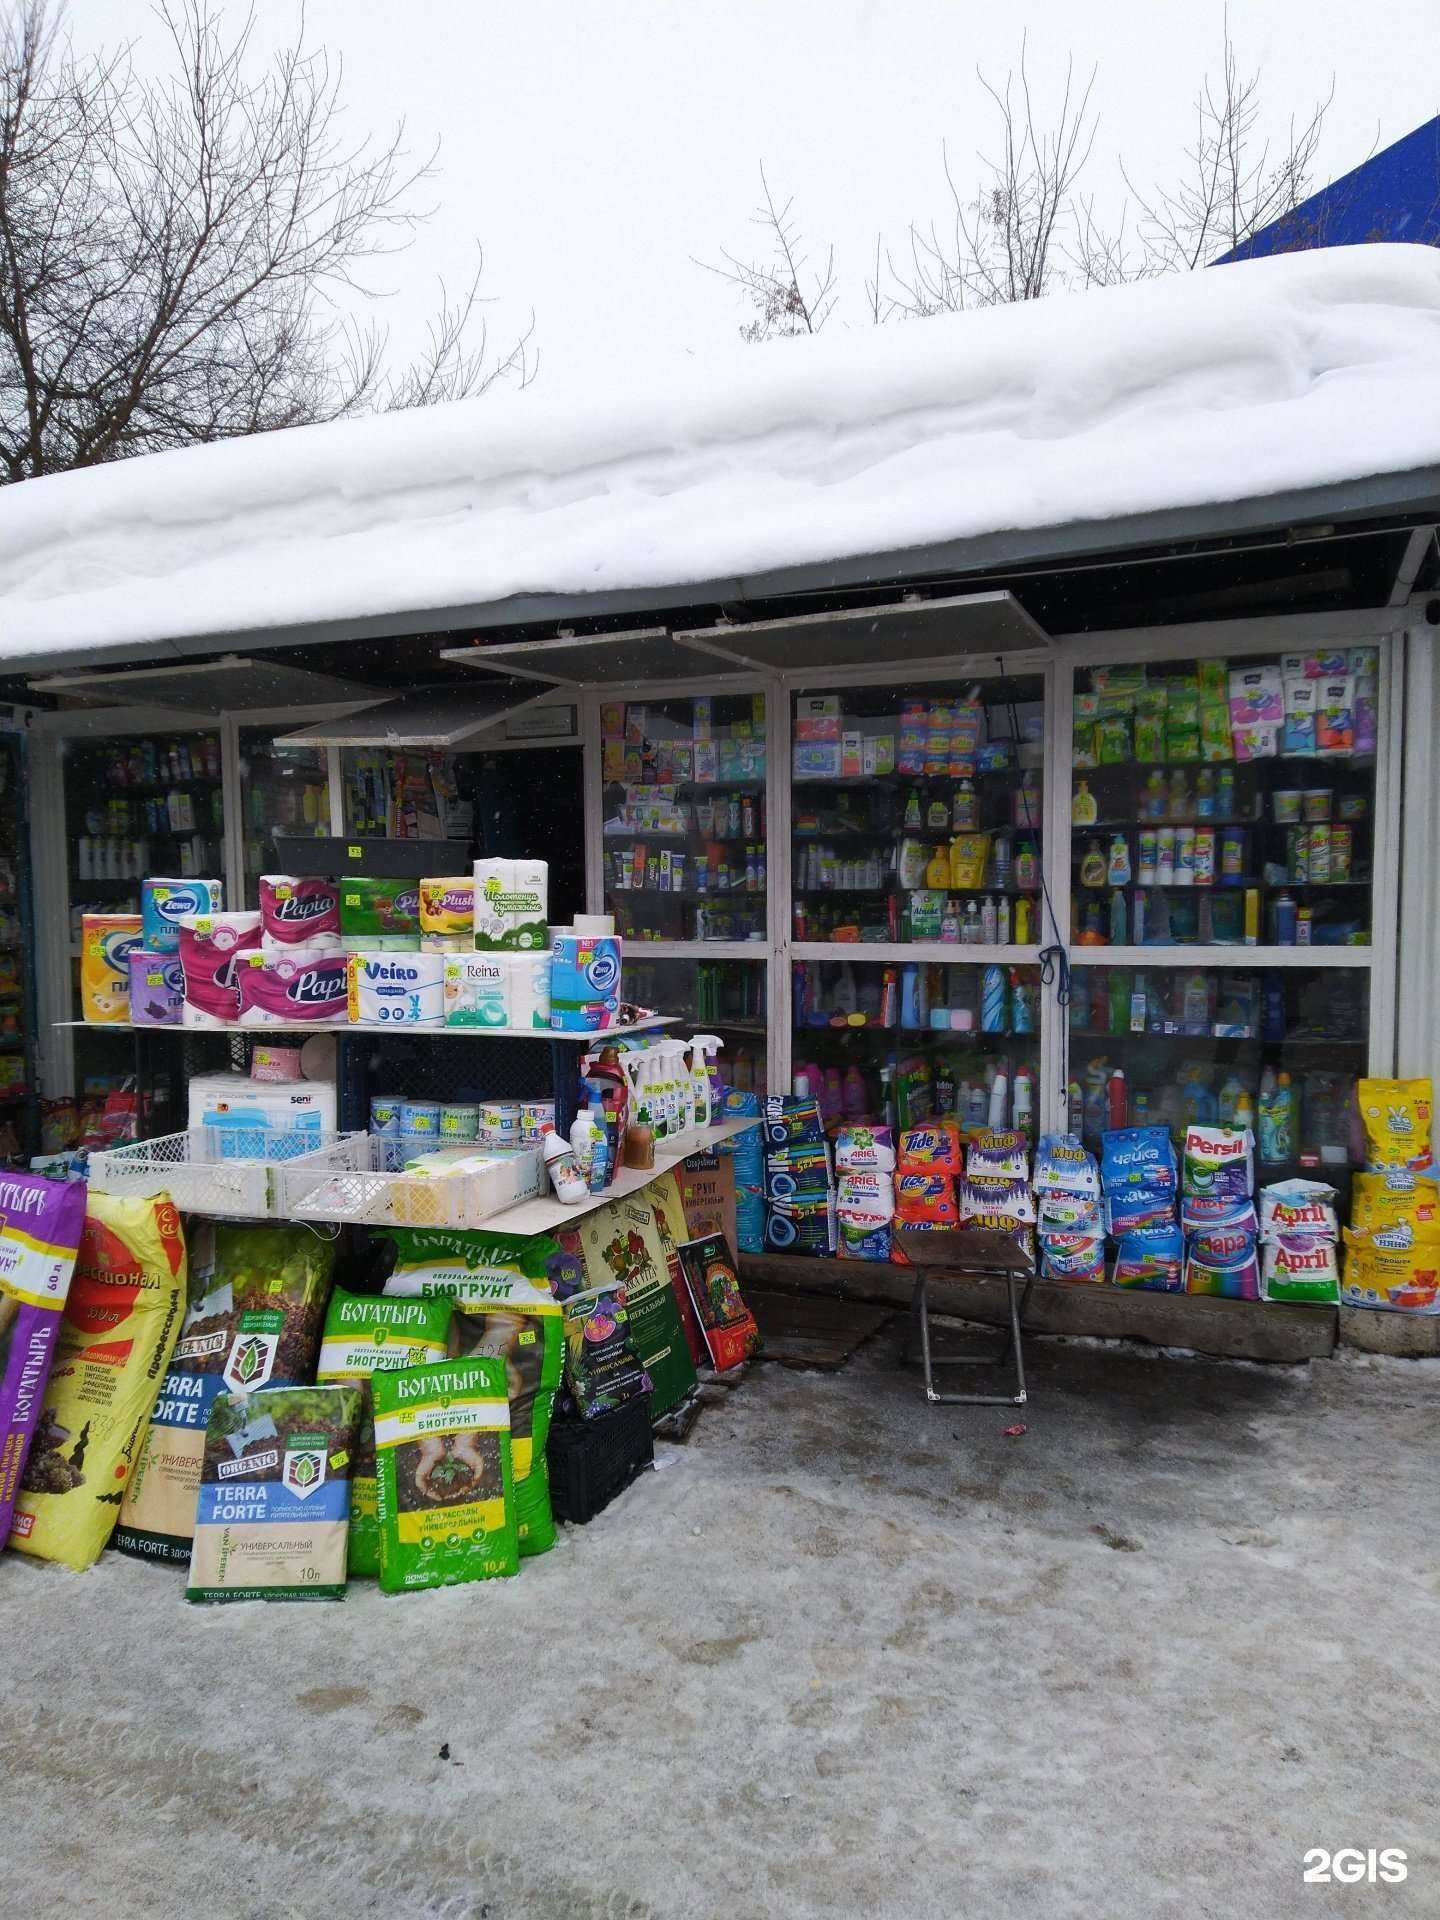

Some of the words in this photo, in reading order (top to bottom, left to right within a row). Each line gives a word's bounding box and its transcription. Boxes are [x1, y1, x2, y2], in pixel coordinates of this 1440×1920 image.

[164, 899, 191, 911] Zewa
[281, 895, 331, 919] Papia
[467, 964, 500, 977] Reina
[290, 1095, 312, 1104] seni
[905, 1132, 935, 1152] Tide
[1187, 1134, 1243, 1155] Persil
[851, 1150, 878, 1158] ARIEL
[847, 1176, 880, 1187] ARIEL
[1275, 1248, 1330, 1273] April
[422, 1282, 513, 1298] БИОГРУНТ
[340, 1302, 427, 1325] БОГАТЫРЬ
[346, 1355, 406, 1369] БИОГРУНТ
[12, 1327, 51, 1423] БОГАТЫРЬ
[160, 1376, 203, 1398] ERRA
[398, 1370, 491, 1398] БОГАТЫРЬ
[152, 1400, 199, 1424] ORTE
[418, 1414, 478, 1430] БИОГРУНТ
[161, 1454, 204, 1469] УНИВЕРС
[222, 1453, 274, 1475] ORGANIC
[215, 1486, 267, 1501] TERRA
[212, 1504, 266, 1520] FORTE
[139, 1540, 169, 1556] FORTE
[170, 1548, 192, 1559] ЗДОР
[240, 1540, 313, 1551] УНИВЕРСАЛЬНЫЙ
